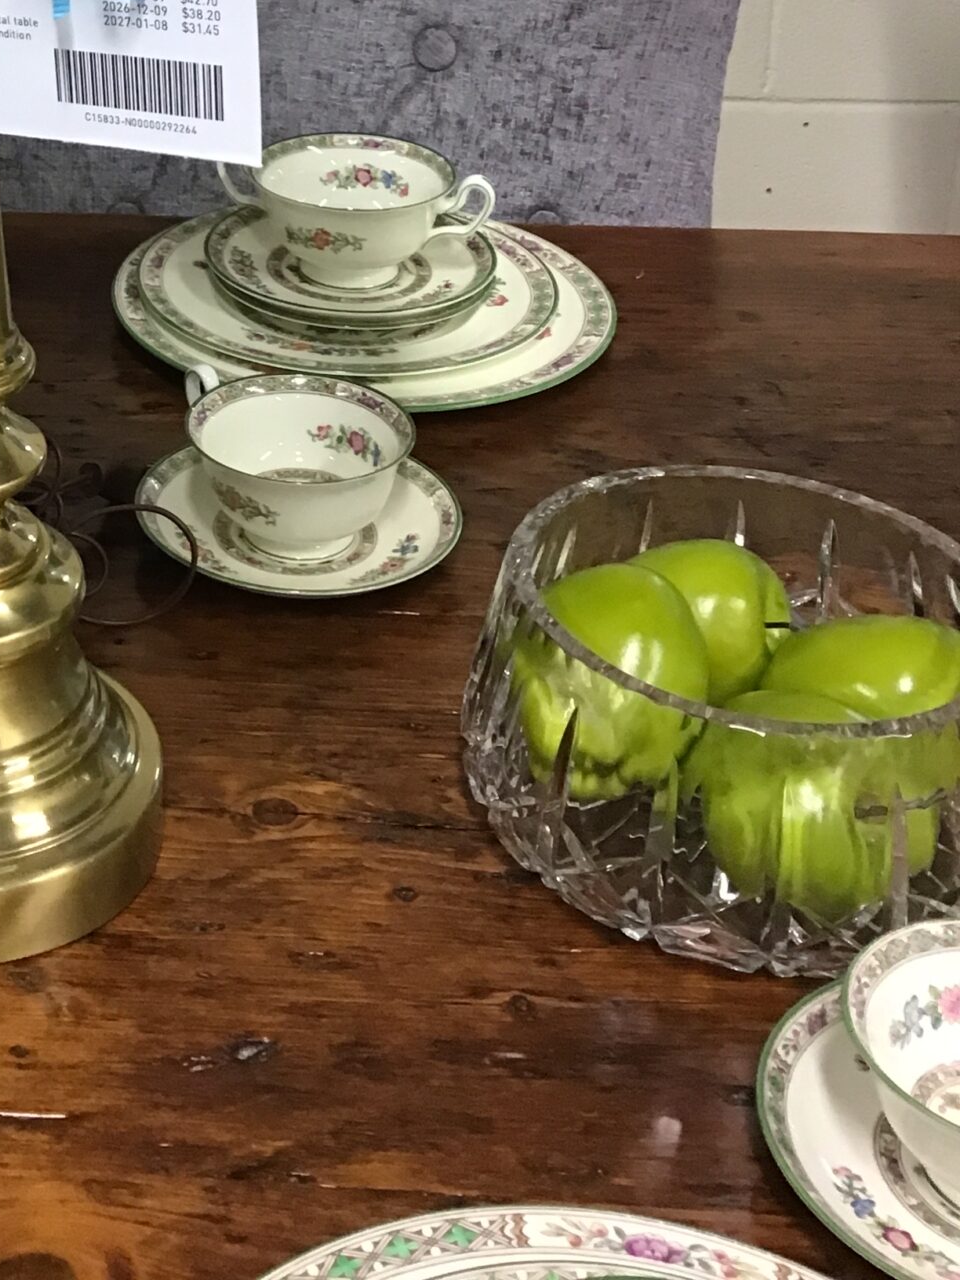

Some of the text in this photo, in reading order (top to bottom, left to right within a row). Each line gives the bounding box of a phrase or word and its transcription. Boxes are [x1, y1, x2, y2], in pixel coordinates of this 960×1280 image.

[102, 0, 221, 22] 2026-12-09 $38.20
[14, 17, 39, 28] table
[103, 14, 220, 36] 2027-01-08 $31.45
